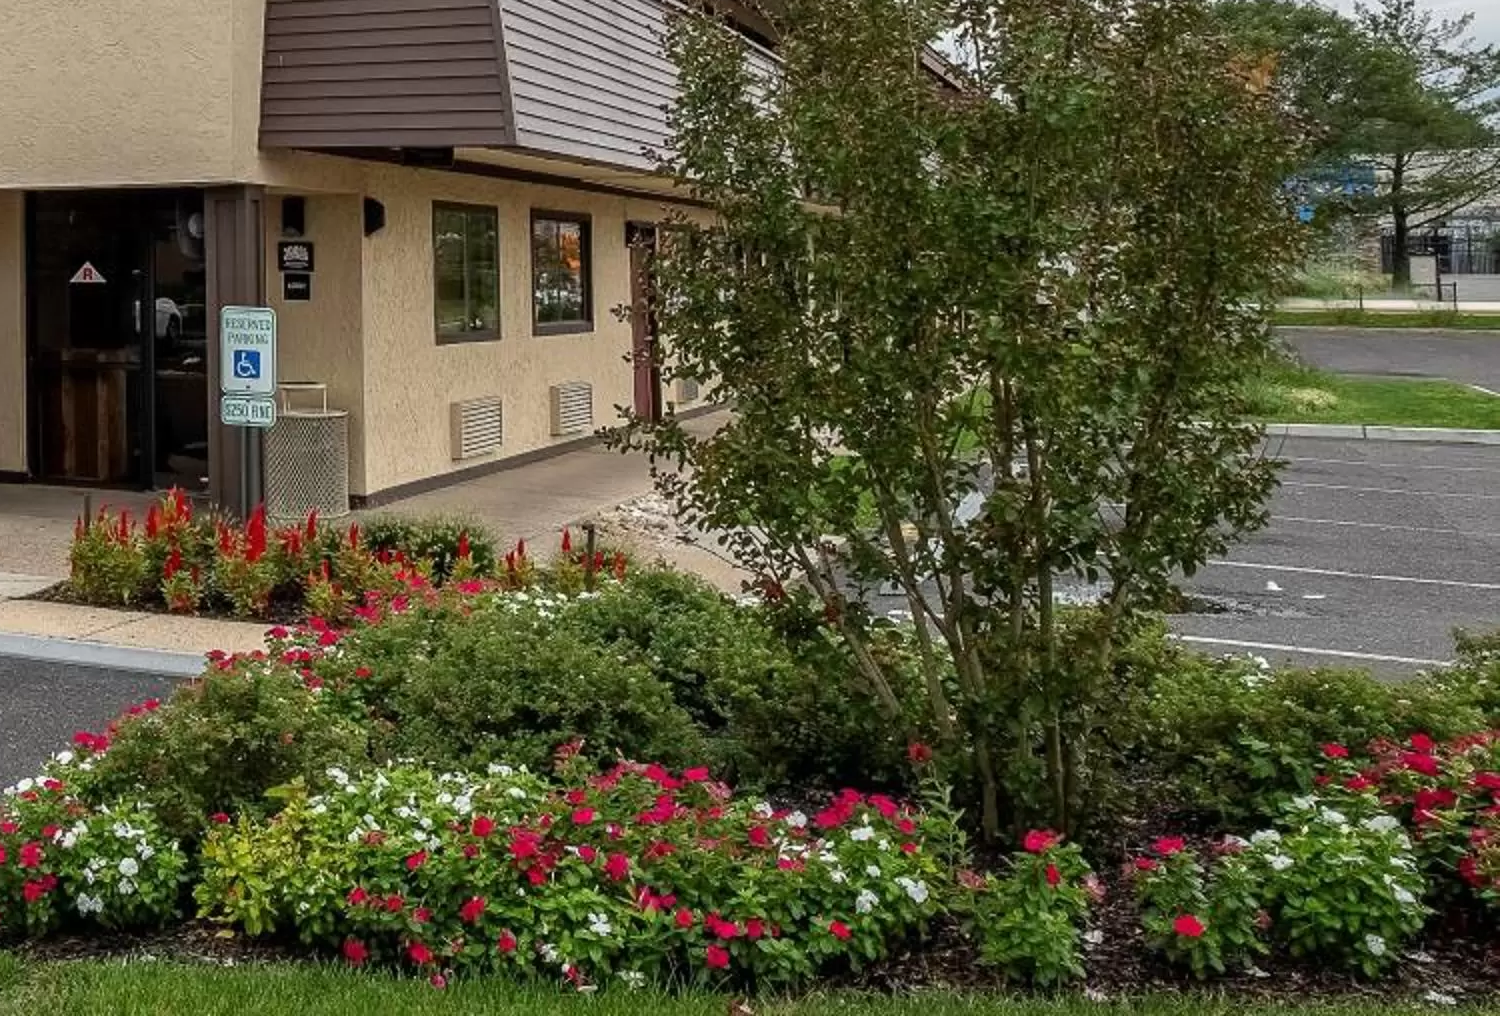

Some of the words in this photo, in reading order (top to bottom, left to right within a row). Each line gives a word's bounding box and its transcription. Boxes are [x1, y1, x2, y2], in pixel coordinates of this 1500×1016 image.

[83, 267, 93, 281] R
[225, 317, 271, 331] RESERVED
[227, 331, 269, 345] PARKING
[225, 404, 249, 417] $250
[251, 404, 271, 419] FINE
